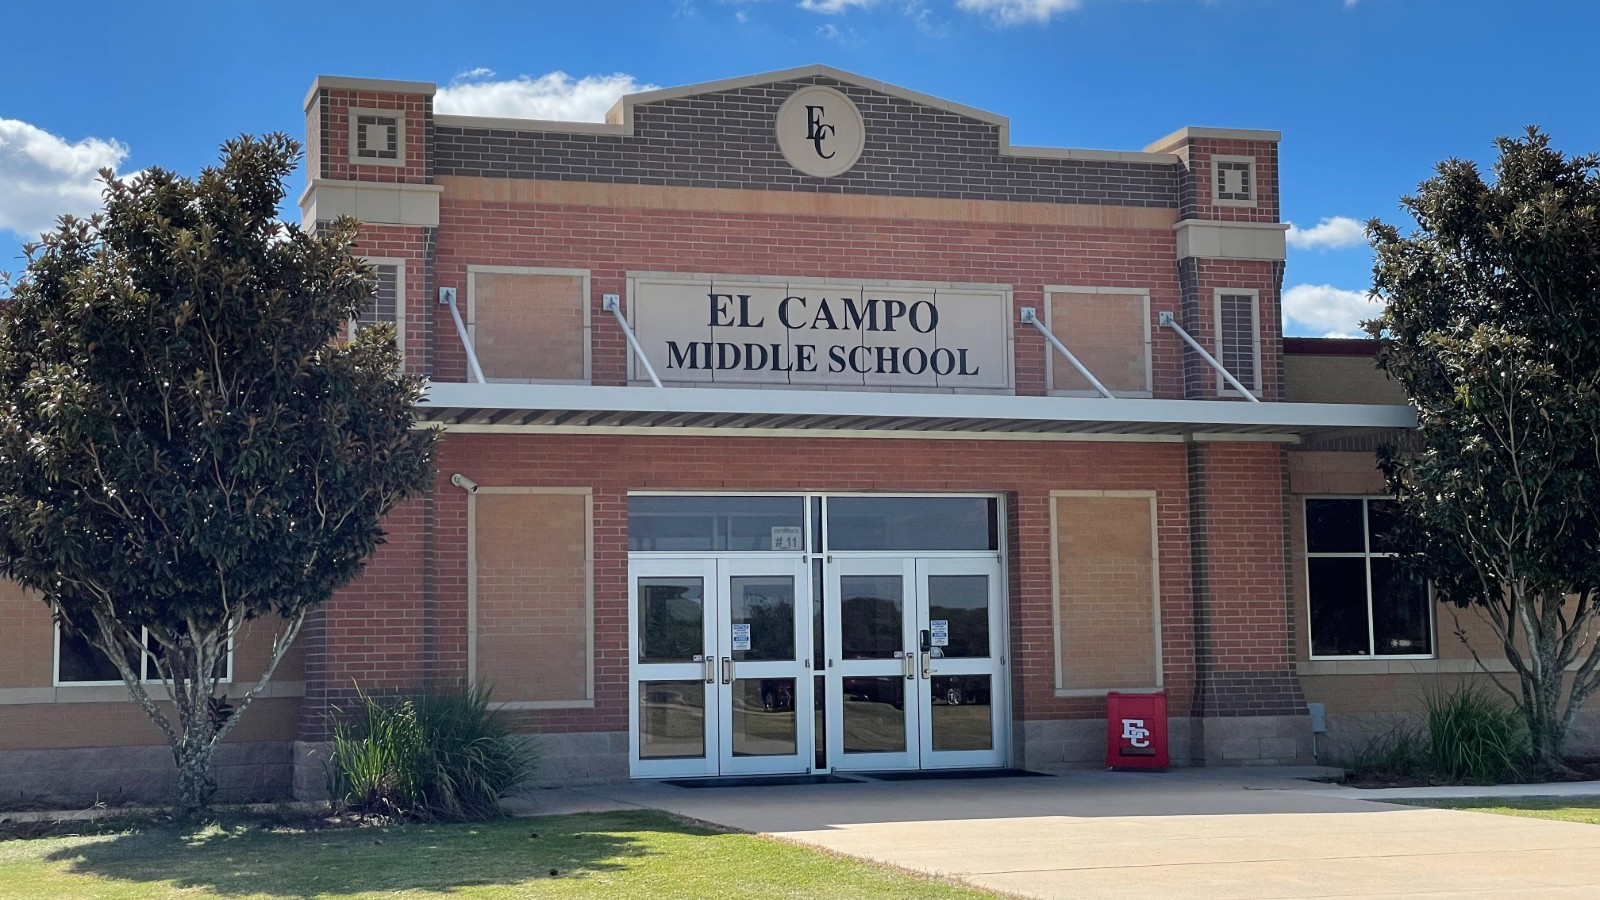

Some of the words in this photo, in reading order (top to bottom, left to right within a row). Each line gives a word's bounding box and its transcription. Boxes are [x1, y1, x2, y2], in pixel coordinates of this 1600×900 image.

[707, 293, 765, 328] EL
[778, 296, 939, 334] CAMPO
[666, 340, 818, 373] MIDDLE
[828, 344, 980, 376] SCHOOL
